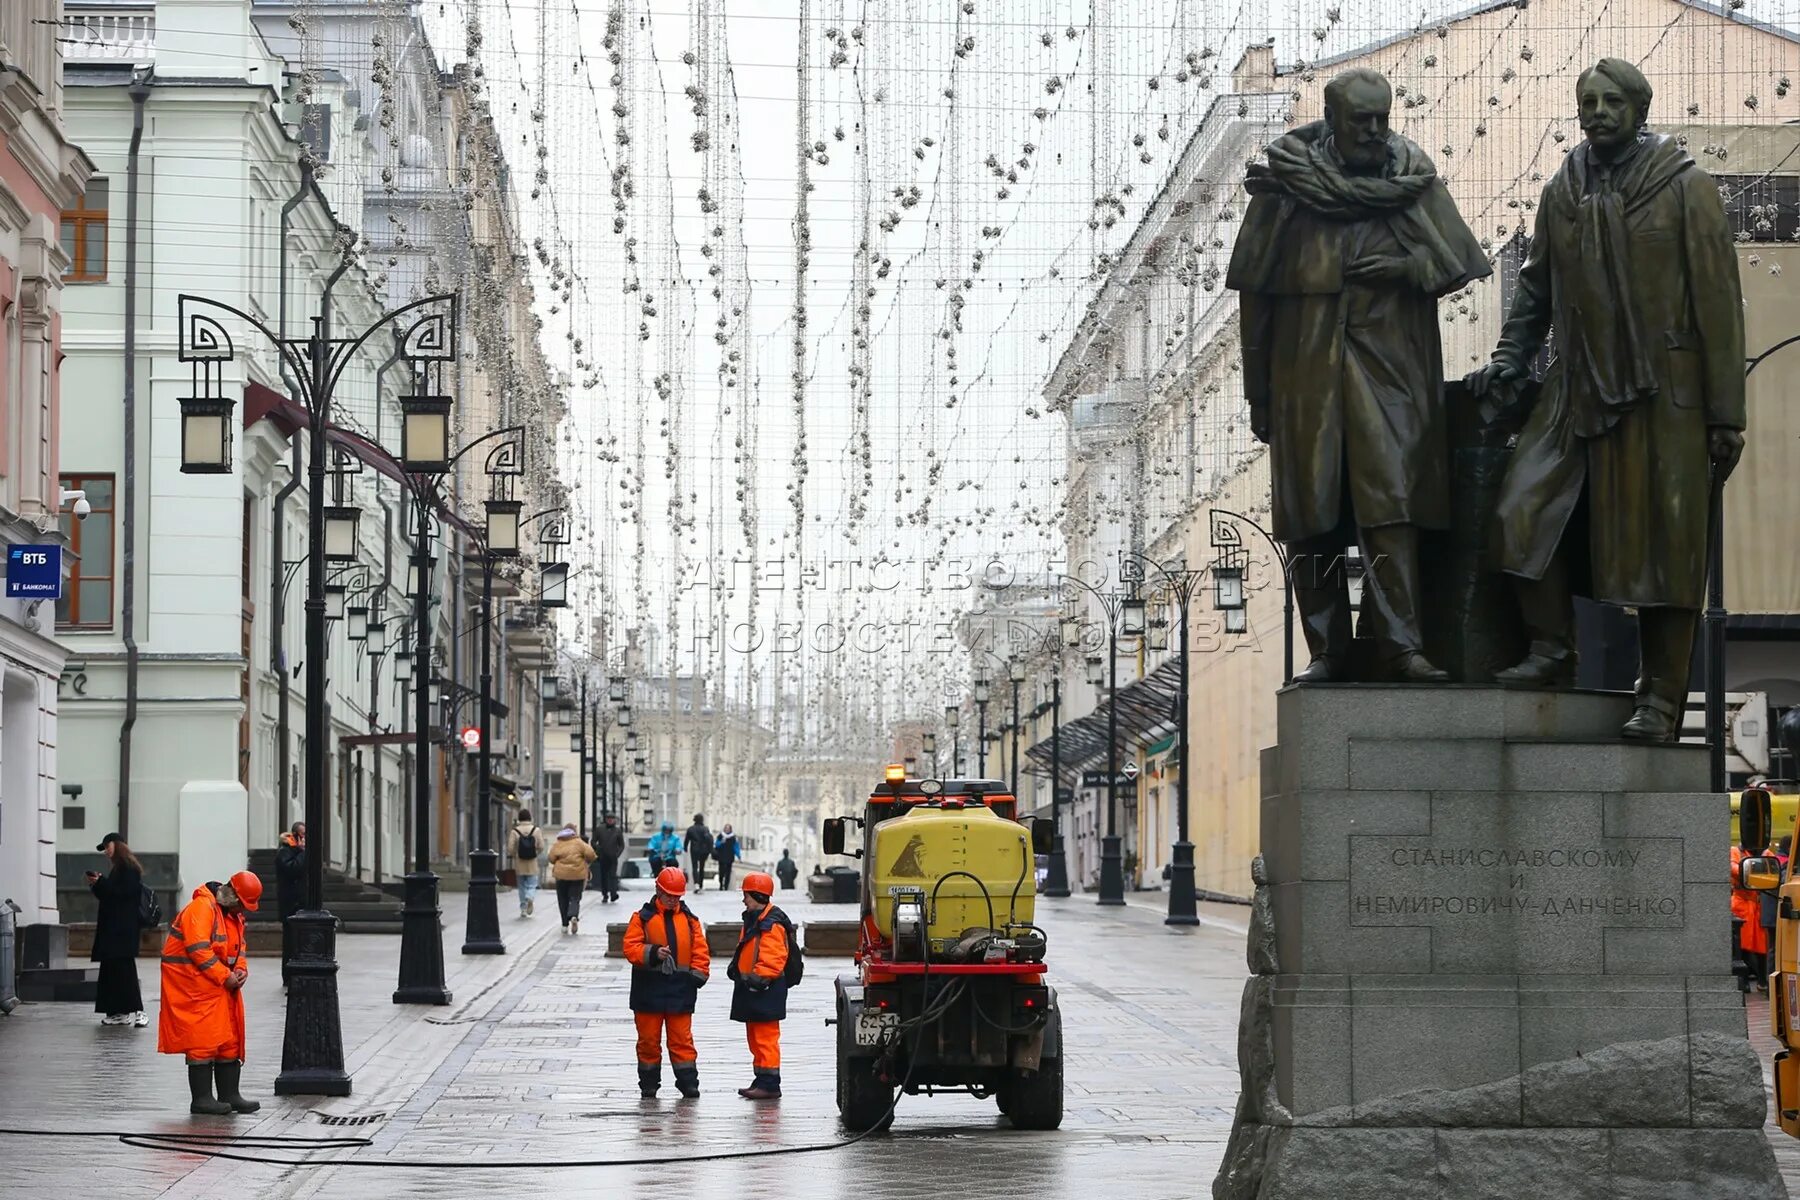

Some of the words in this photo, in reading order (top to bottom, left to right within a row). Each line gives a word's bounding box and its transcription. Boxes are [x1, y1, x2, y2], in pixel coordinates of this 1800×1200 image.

[23, 553, 47, 565] ВТБ
[1391, 848, 1641, 868] СТАНИСЛАВСКОМУ
[1509, 873, 1525, 890] И
[1355, 896, 1677, 917] НЕМИРОВИЧУ-ДАНЧЕНКО
[860, 1015, 895, 1029] 6251
[858, 1033, 876, 1044] НХ
